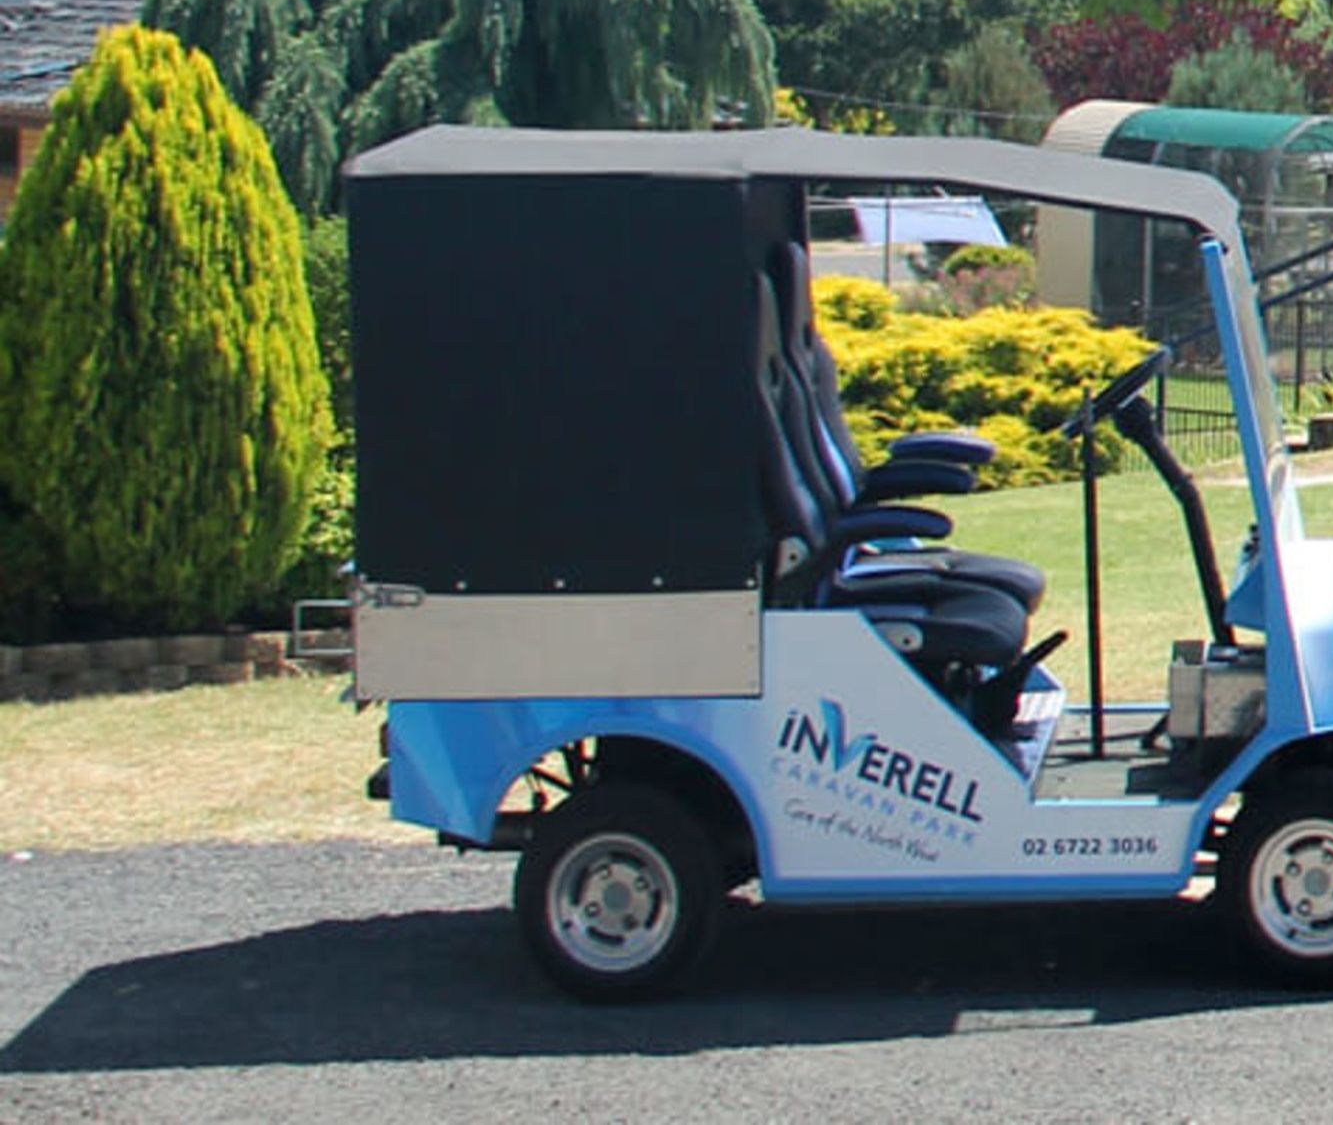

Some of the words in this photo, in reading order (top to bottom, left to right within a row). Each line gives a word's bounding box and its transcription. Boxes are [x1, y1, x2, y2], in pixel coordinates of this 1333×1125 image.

[770, 756, 896, 816] CARAVAN
[909, 809, 977, 848] PARK
[1022, 838, 1047, 856] 02
[1053, 838, 1102, 856] 6722
[1109, 836, 1157, 855] 3036
